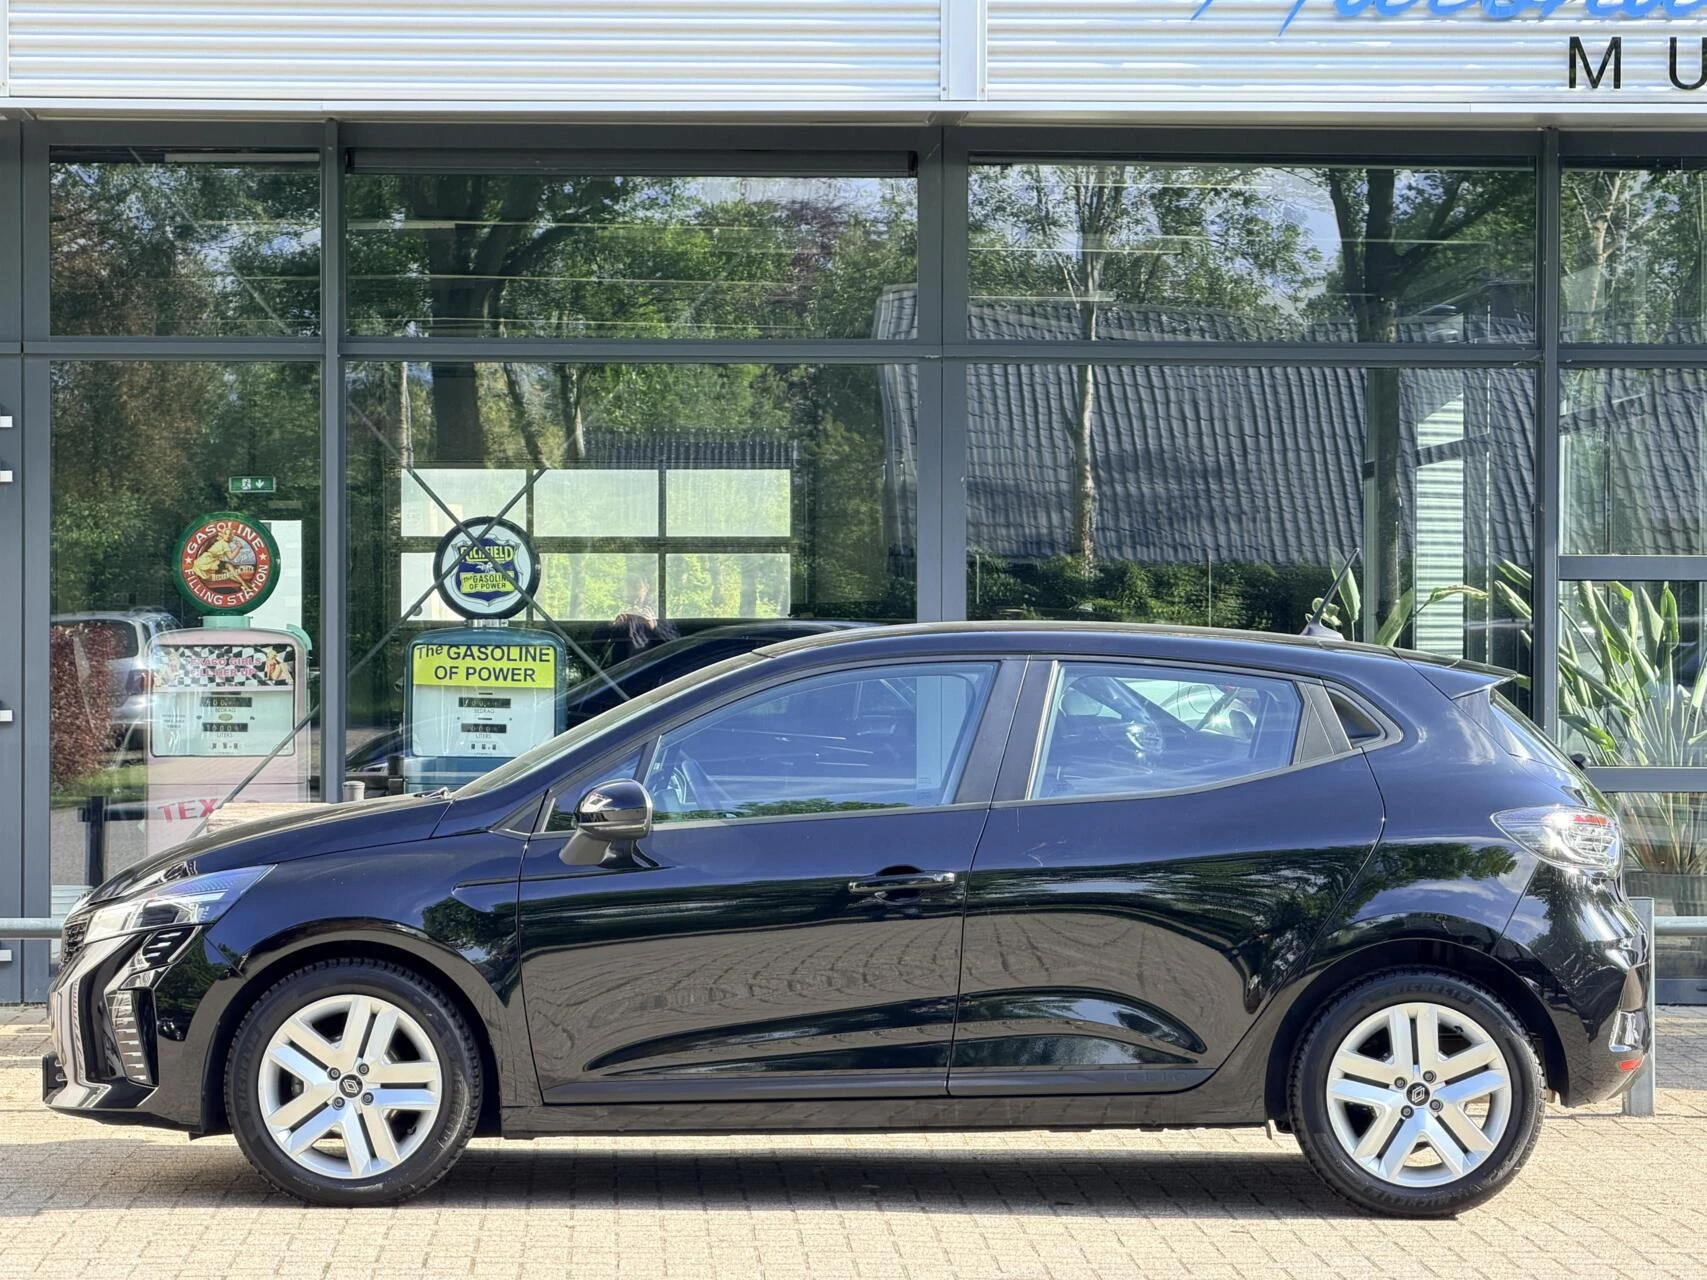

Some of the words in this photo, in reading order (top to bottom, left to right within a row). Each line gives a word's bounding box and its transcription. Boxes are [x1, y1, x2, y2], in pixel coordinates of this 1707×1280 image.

[185, 568, 223, 605] FILLING
[227, 564, 269, 605] STATION
[473, 573, 508, 583] GASOLIN
[229, 657, 262, 666] GIRLS
[416, 645, 443, 659] The
[447, 646, 551, 663] GASOLINE
[216, 668, 237, 677] HER
[241, 667, 257, 676] UP
[434, 666, 459, 680] OF
[465, 667, 536, 682] POWER
[157, 798, 222, 823] TEX
